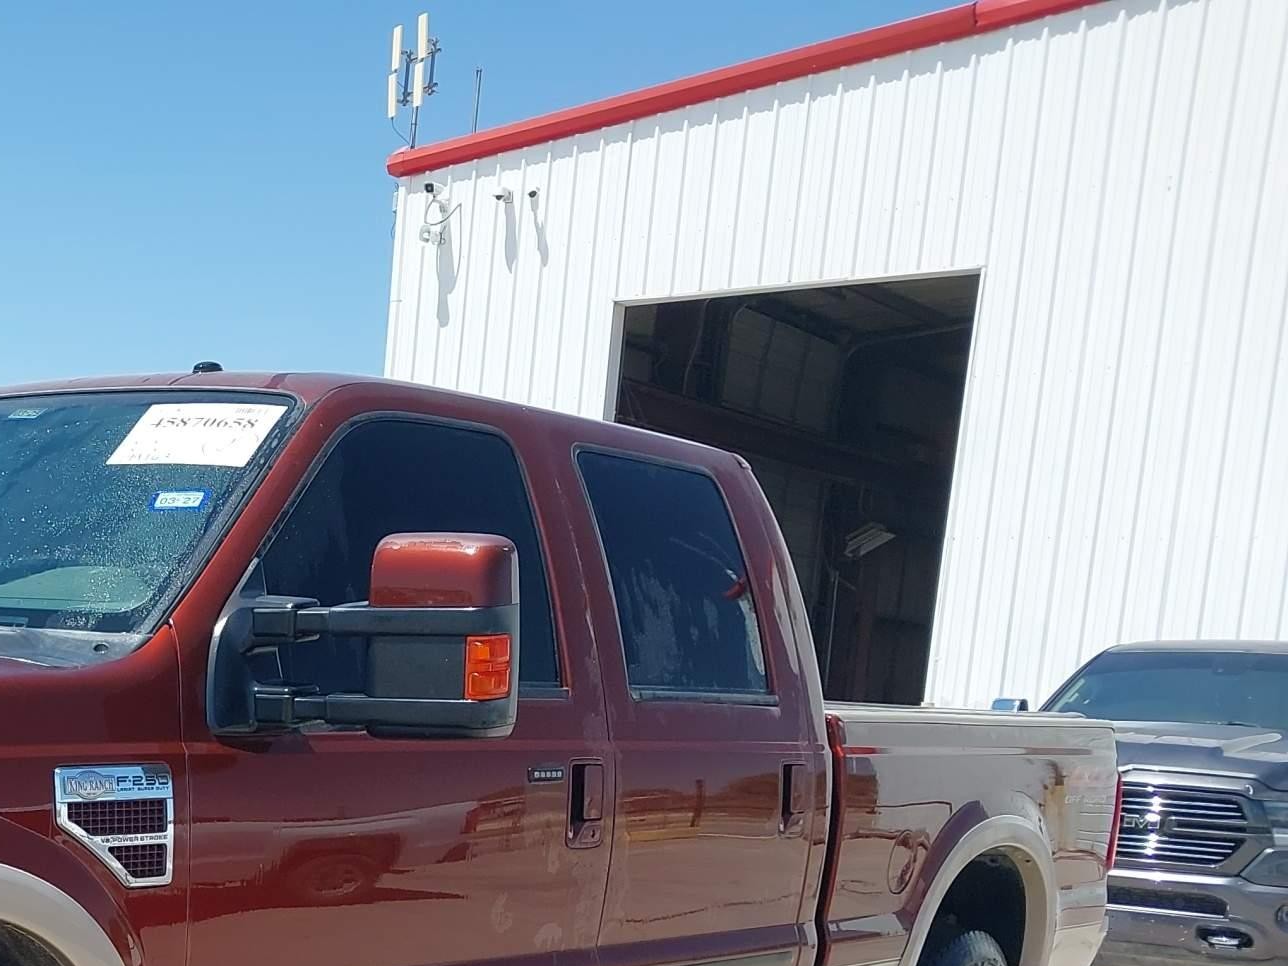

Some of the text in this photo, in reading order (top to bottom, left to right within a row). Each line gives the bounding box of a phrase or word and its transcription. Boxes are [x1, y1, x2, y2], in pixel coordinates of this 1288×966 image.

[151, 417, 259, 429] 45870658
[68, 776, 115, 793] KING RANCH
[112, 835, 139, 843] POWER
[140, 834, 168, 842] STROKE
